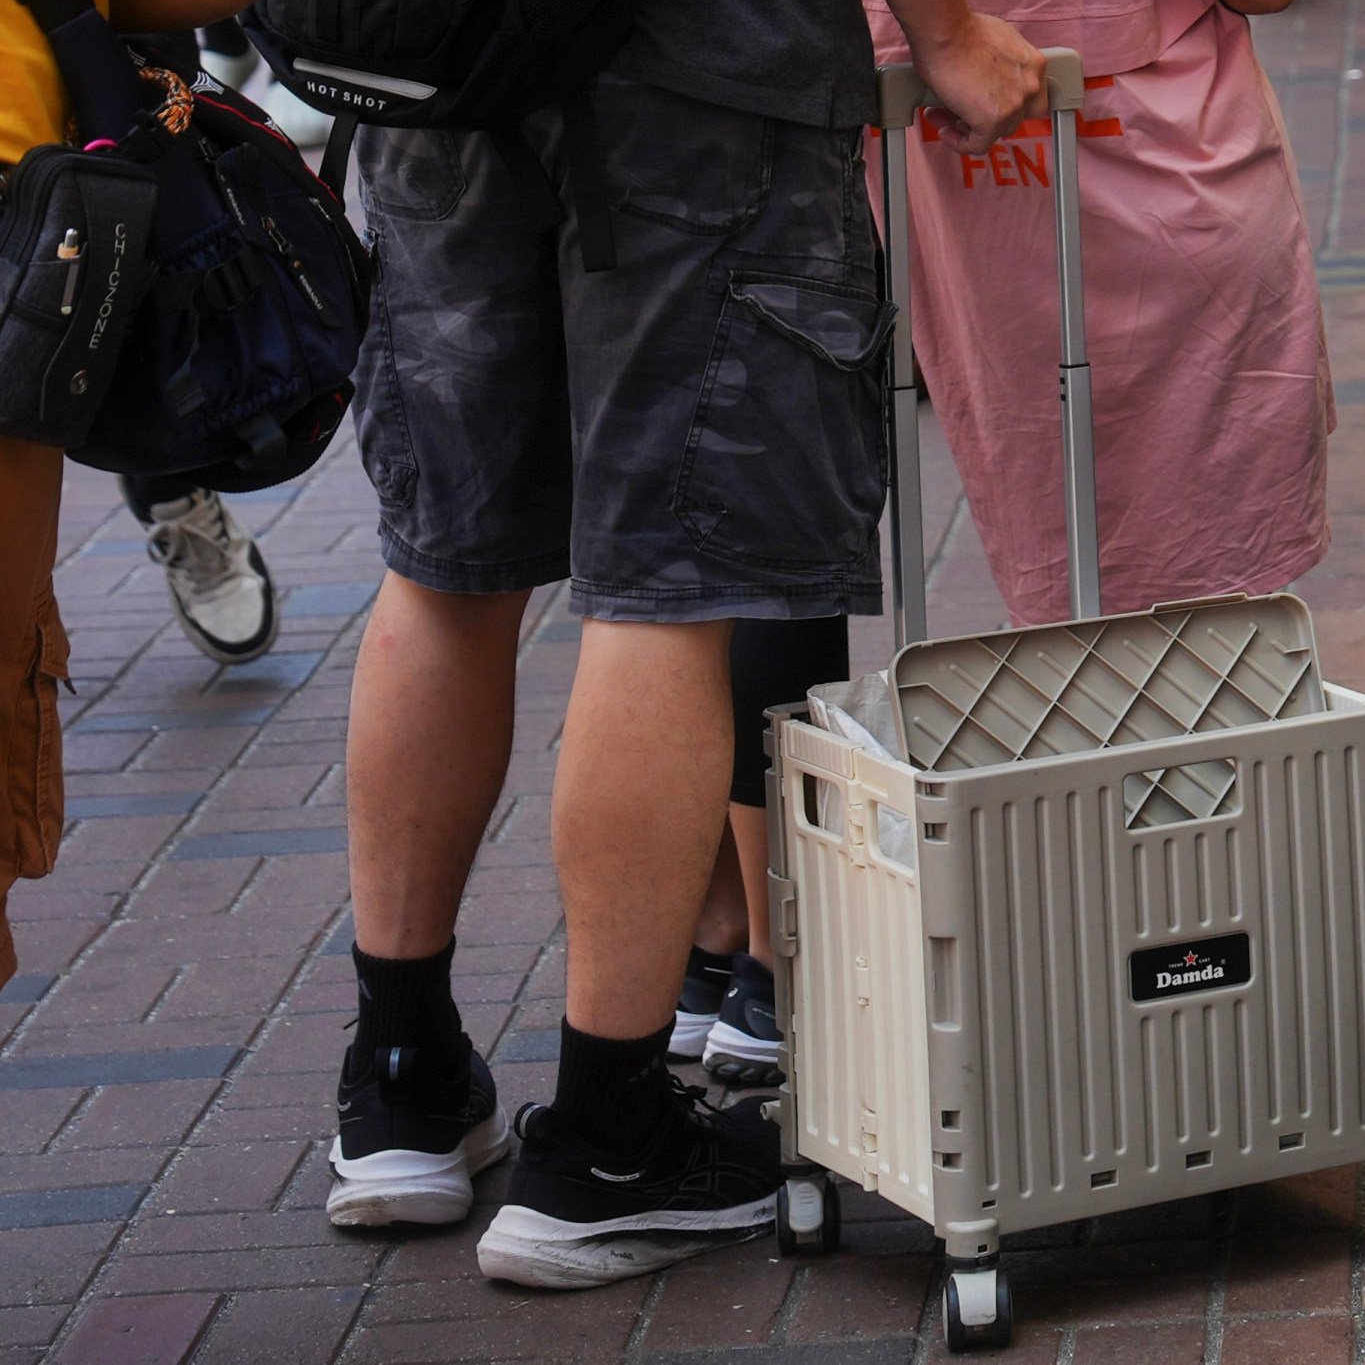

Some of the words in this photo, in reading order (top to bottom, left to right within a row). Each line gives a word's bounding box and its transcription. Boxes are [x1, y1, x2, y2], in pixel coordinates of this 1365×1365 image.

[307, 81, 338, 98] HOT
[343, 92, 386, 110] SHOT
[960, 143, 1049, 188] FEN
[89, 223, 126, 349] CHICZONE
[1156, 964, 1224, 989] Damda
